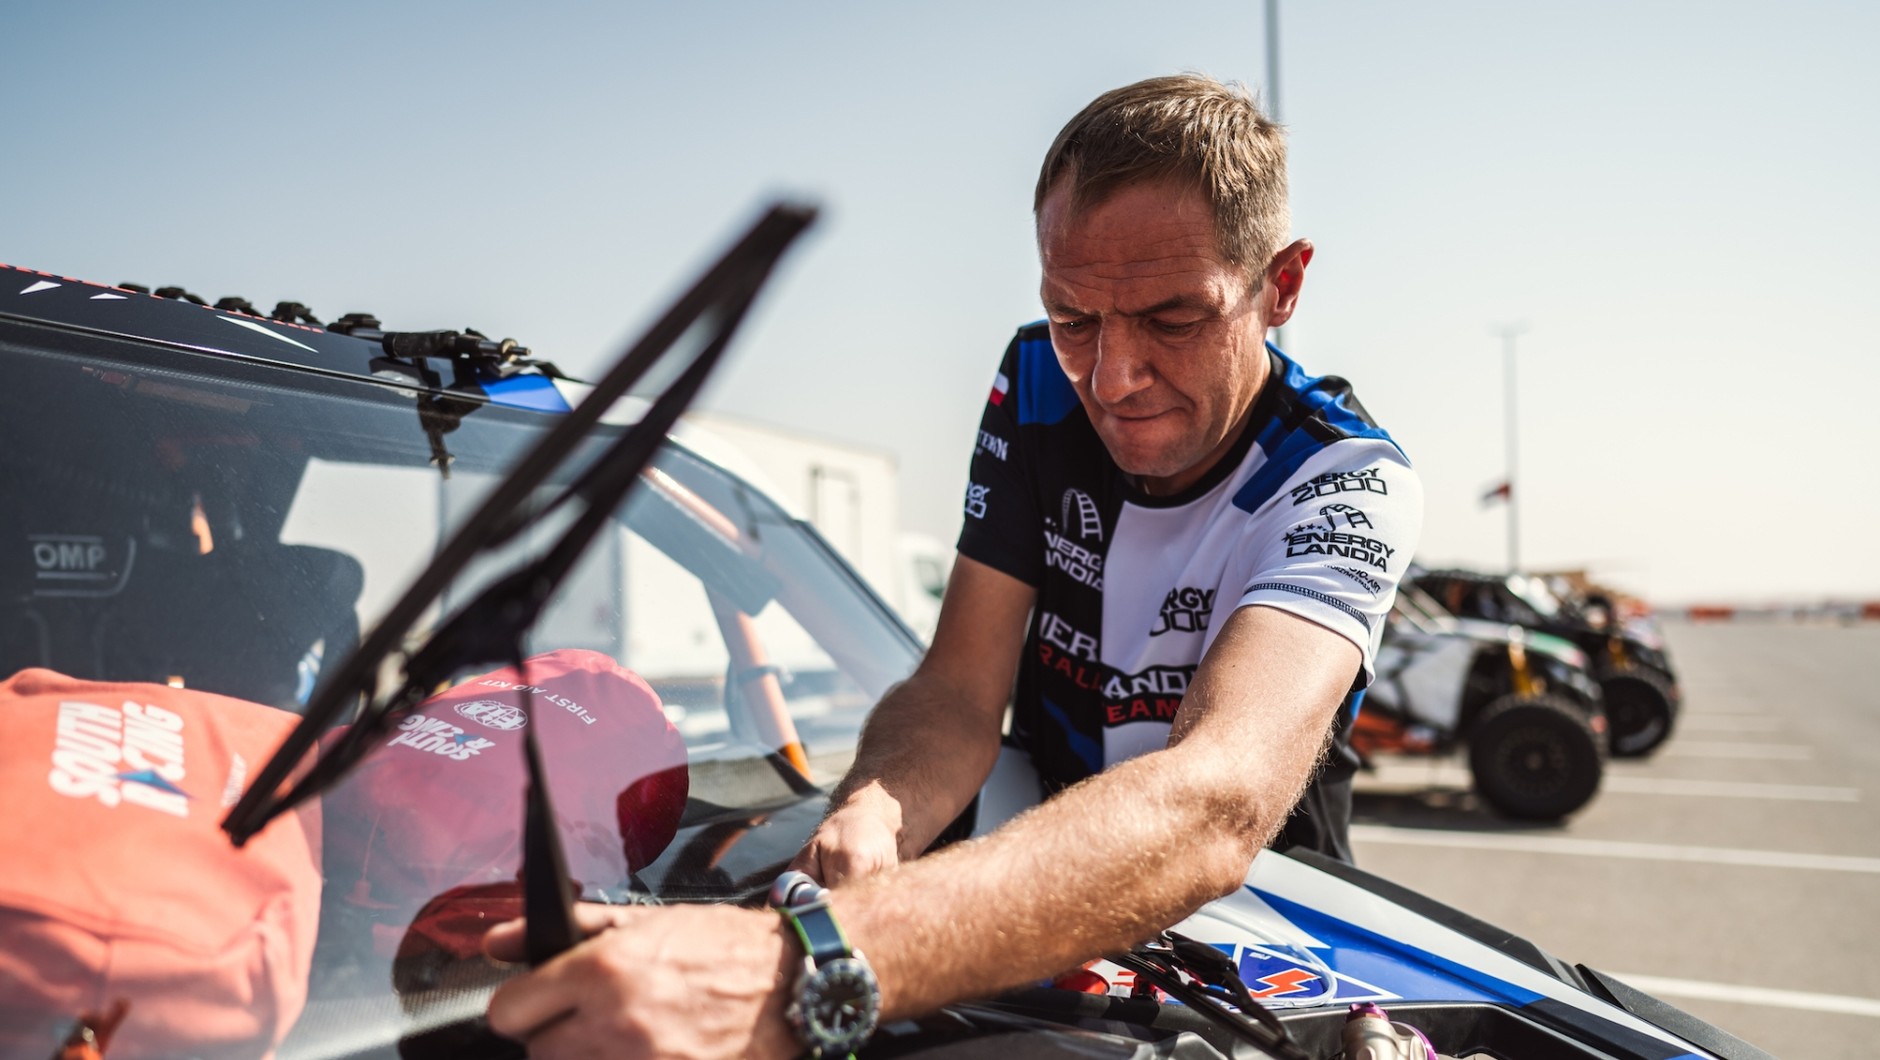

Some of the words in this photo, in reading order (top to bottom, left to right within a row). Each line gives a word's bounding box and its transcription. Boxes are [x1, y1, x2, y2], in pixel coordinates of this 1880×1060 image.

[1291, 477, 1388, 507] 2000
[33, 542, 106, 570] OMP
[1285, 543, 1388, 573] LANDIA
[1287, 531, 1396, 559] ENERGY
[478, 679, 512, 689] KIT
[511, 683, 548, 695] AID
[544, 693, 598, 726] FIRST
[48, 700, 123, 809] SOUTH
[386, 730, 481, 761] SOUTH
